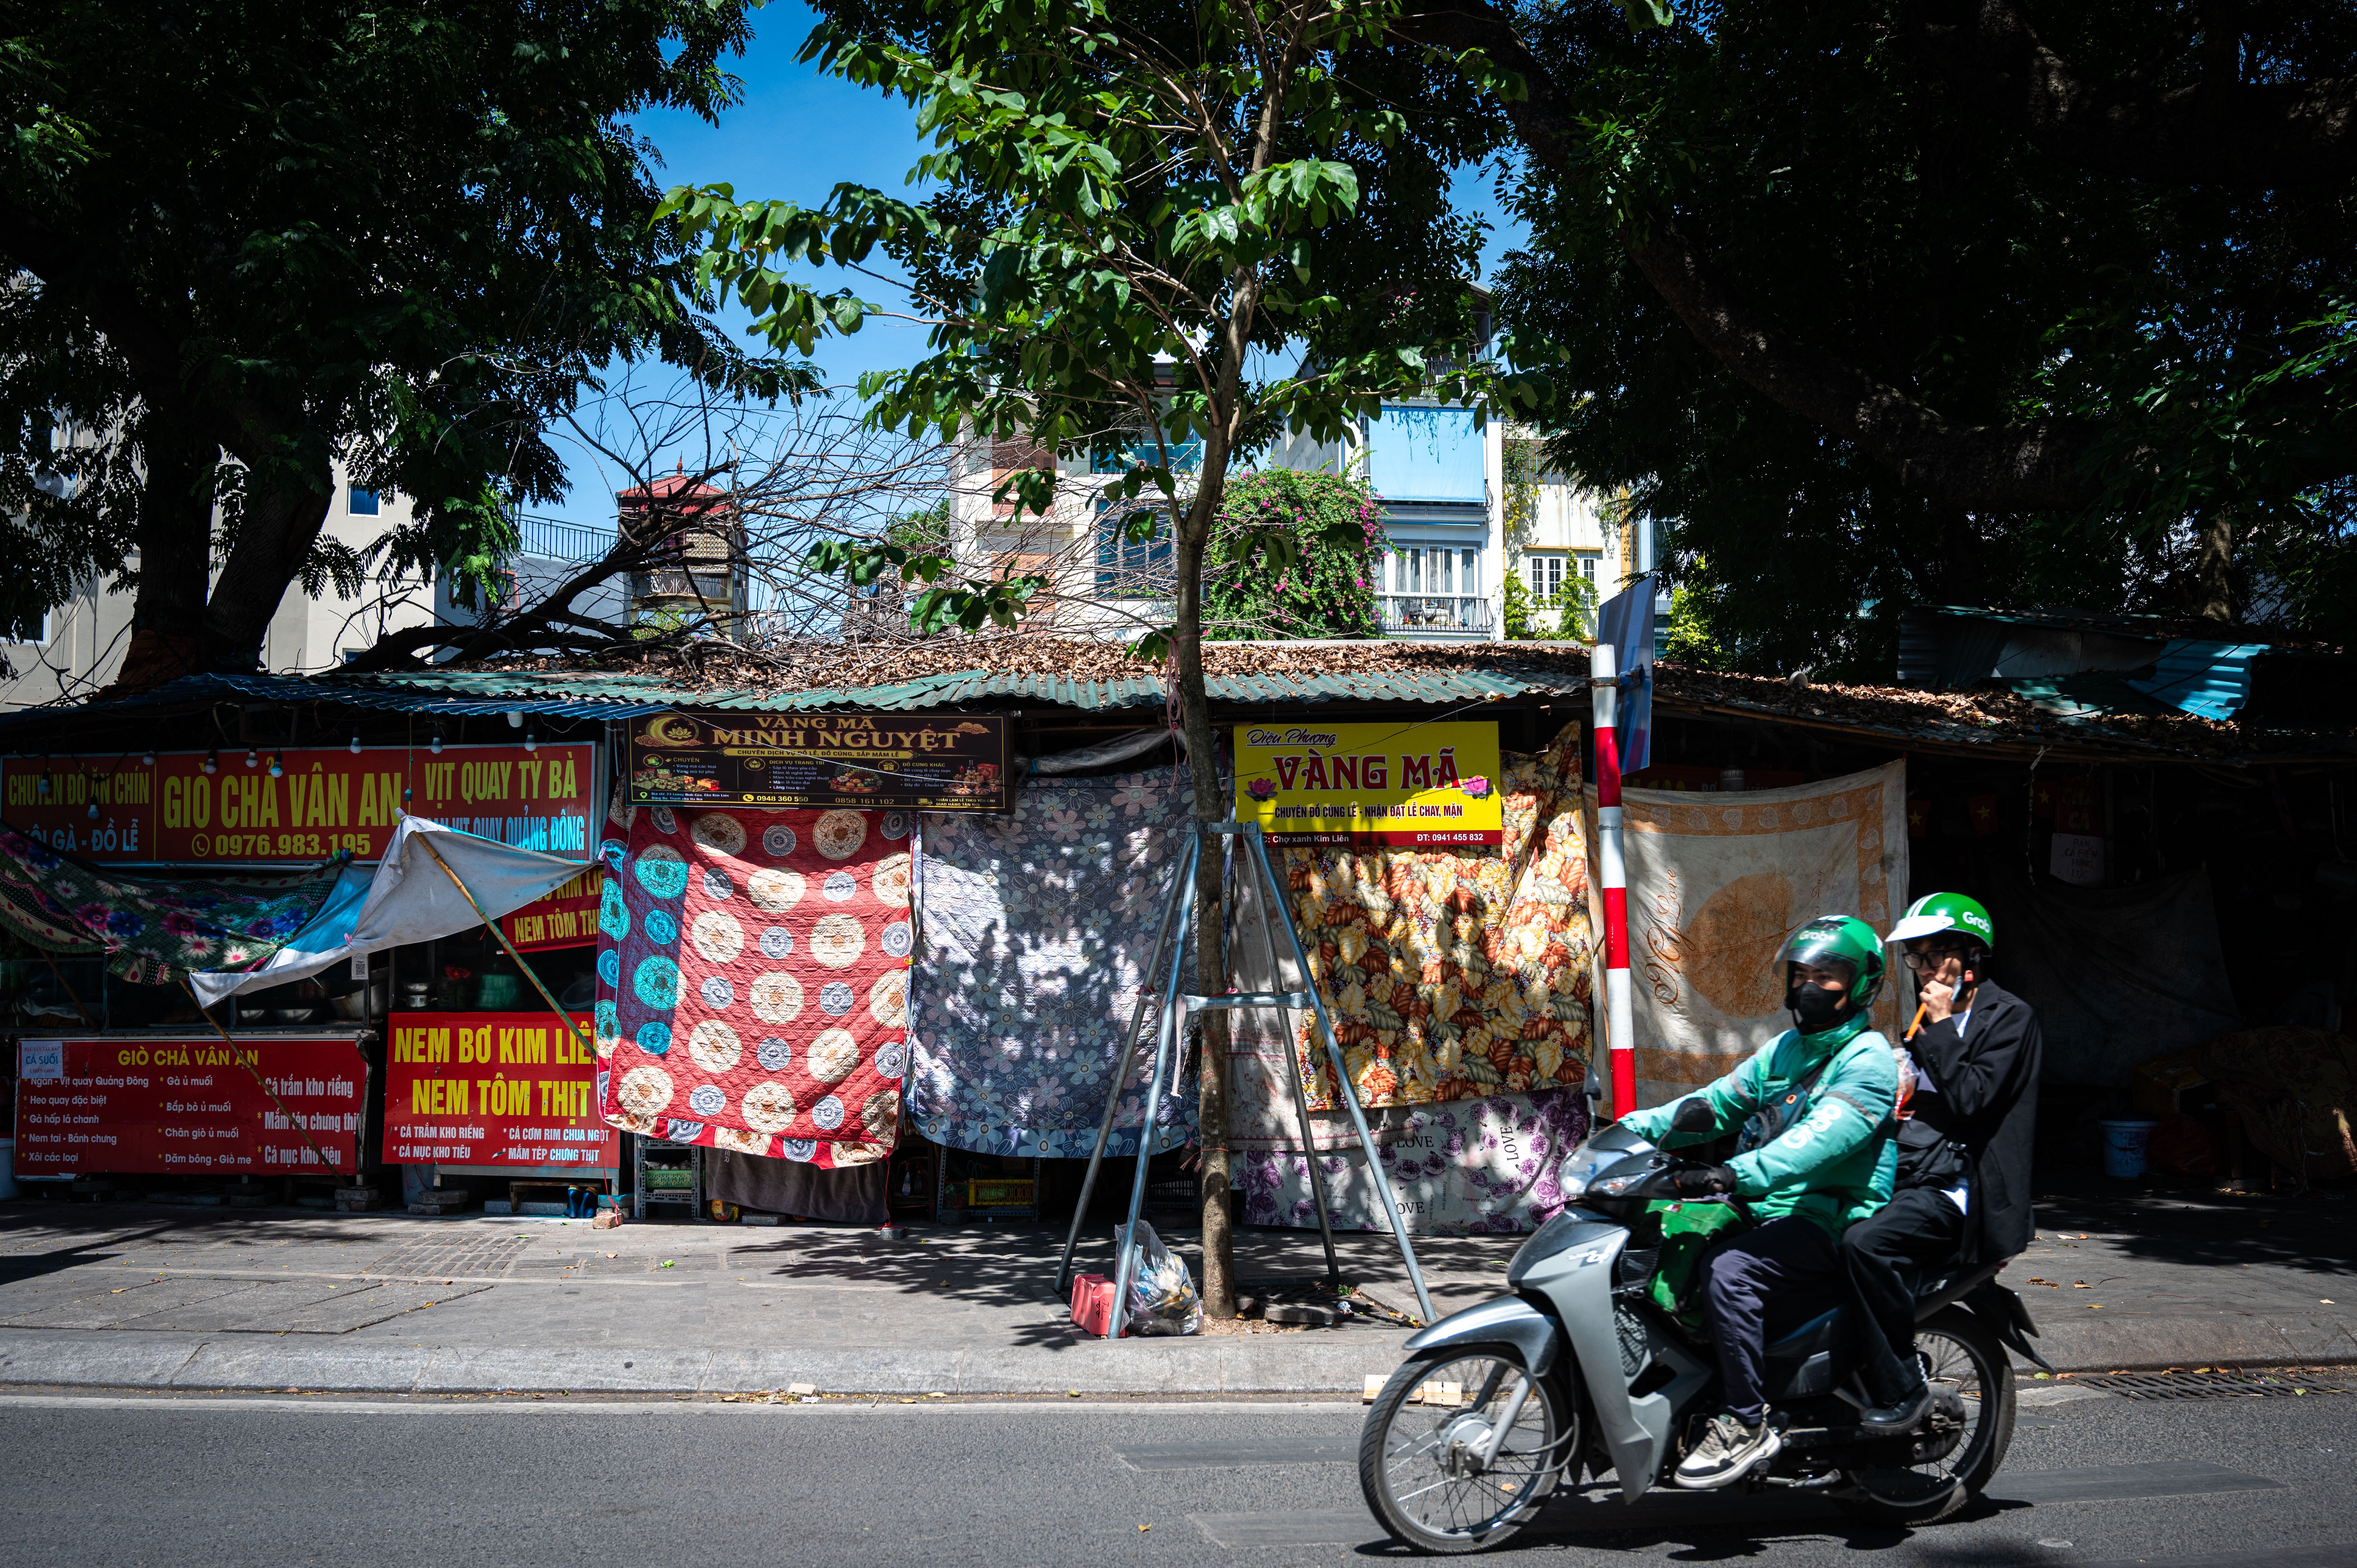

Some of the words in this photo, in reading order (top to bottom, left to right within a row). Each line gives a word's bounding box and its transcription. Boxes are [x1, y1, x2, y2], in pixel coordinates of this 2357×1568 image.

[755, 715, 827, 729] VÀNG
[837, 717, 875, 729] MÃ
[712, 729, 806, 747] MINH
[818, 729, 960, 751] NGUYỆT
[1246, 729, 1282, 745] Diệu
[1272, 748, 1388, 790] VÀNG
[1399, 746, 1462, 790] MÃ
[67, 762, 86, 805] ĐỒ
[91, 766, 111, 804] ĂN
[115, 765, 150, 805] CHÍN
[425, 762, 455, 809] VỊT
[461, 761, 512, 805] QUAY
[518, 752, 543, 799] TỲ
[548, 751, 577, 798] BÀ
[164, 762, 210, 830] GIÒ
[221, 756, 279, 829] CHẢ
[289, 762, 349, 827] VÂN
[359, 772, 401, 826] AN
[1275, 804, 1307, 818] CHUYÊN
[1309, 803, 1320, 818] ĐỒ
[1323, 804, 1345, 818] CÚNG
[1347, 802, 1357, 817] LỄ
[1364, 803, 1387, 820] NHẬN
[1390, 803, 1405, 819] ĐẶT
[1408, 801, 1417, 817] LỄ
[1419, 805, 1441, 818] CHAY,
[1444, 803, 1462, 819] MẶN
[53, 823, 77, 851] GÀ
[92, 817, 117, 851] ĐỒ
[122, 818, 139, 851] LỄ
[506, 805, 548, 851] QUẢNG
[550, 809, 585, 851] ĐÔNG
[215, 833, 370, 856] 0976.983.195
[1272, 835, 1290, 844] Chợ
[514, 915, 545, 943] NEM
[547, 908, 577, 939] TÔM
[1962, 911, 1991, 934] Grab
[394, 1028, 450, 1063] NEM
[458, 1024, 492, 1063] BƠ
[499, 1028, 547, 1064] KIM
[555, 1021, 597, 1065] LIÊ
[26, 1053, 37, 1065] CÁ
[39, 1052, 58, 1064] SUỐI
[118, 1045, 149, 1066] GIÒ
[154, 1044, 190, 1066] CHẢ
[195, 1045, 230, 1066] VÂN
[235, 1050, 258, 1066] AN
[31, 1078, 53, 1088] Ngan
[60, 1076, 70, 1088] Vịt
[72, 1078, 93, 1088] quay
[95, 1075, 124, 1088] Quảng
[126, 1076, 149, 1088] Đông
[167, 1076, 180, 1086] Gà
[182, 1075, 189, 1086] ủ
[191, 1075, 213, 1086] muối
[265, 1077, 278, 1096] Cá
[281, 1074, 303, 1096] trắm
[306, 1077, 325, 1096] kho
[327, 1074, 353, 1098] riềng
[30, 1095, 46, 1105] Heo
[49, 1097, 69, 1106] quay
[71, 1095, 88, 1107] đặc
[90, 1095, 107, 1107] biệt
[166, 1101, 184, 1113] Bắp
[187, 1102, 198, 1112] bò
[201, 1102, 207, 1112] ủ
[208, 1101, 231, 1112] muối
[412, 1079, 469, 1115] NEM
[477, 1072, 530, 1116] TÔM
[538, 1080, 591, 1125] THỊT
[30, 1114, 42, 1124] Gà
[44, 1113, 60, 1125] hấp
[63, 1114, 71, 1124] lá
[73, 1114, 99, 1124] chanh
[265, 1107, 289, 1130] Mắm
[310, 1112, 341, 1133] chưng
[29, 1133, 48, 1143] Nem
[50, 1134, 61, 1143] tai
[68, 1133, 89, 1143] Bánh
[90, 1134, 117, 1145] chưng
[165, 1127, 189, 1137] Chân
[192, 1128, 206, 1139] giò
[208, 1128, 214, 1138] ủ
[216, 1127, 239, 1138] muối
[400, 1125, 412, 1138] CÁ
[414, 1122, 437, 1138] TRẮM
[439, 1126, 457, 1139] KHO
[459, 1123, 484, 1139] RIỀNG
[509, 1125, 521, 1140] CÁ
[523, 1127, 542, 1141] CƠM
[544, 1128, 561, 1141] RIM
[563, 1128, 585, 1141] CHUA
[587, 1129, 610, 1145] NGỌT
[1397, 1136, 1434, 1148] LOVE
[1500, 1127, 1519, 1161] LOVE
[28, 1152, 42, 1162] Xôi
[44, 1152, 60, 1162] các
[63, 1153, 78, 1164] loại
[165, 1153, 186, 1163] Dăm
[189, 1153, 212, 1166] bông
[265, 1145, 277, 1164] Cá
[280, 1149, 298, 1168] nục
[300, 1146, 319, 1164] kho
[399, 1144, 410, 1158] CÁ
[413, 1146, 431, 1162] NỤC
[433, 1146, 450, 1158] KHO
[452, 1144, 471, 1159] TIÊU
[508, 1144, 530, 1160] MẮM
[532, 1145, 547, 1160] TÉP
[549, 1147, 579, 1161] CHƯNG
[581, 1148, 599, 1164] THỊT
[1396, 1201, 1425, 1215] OVE
